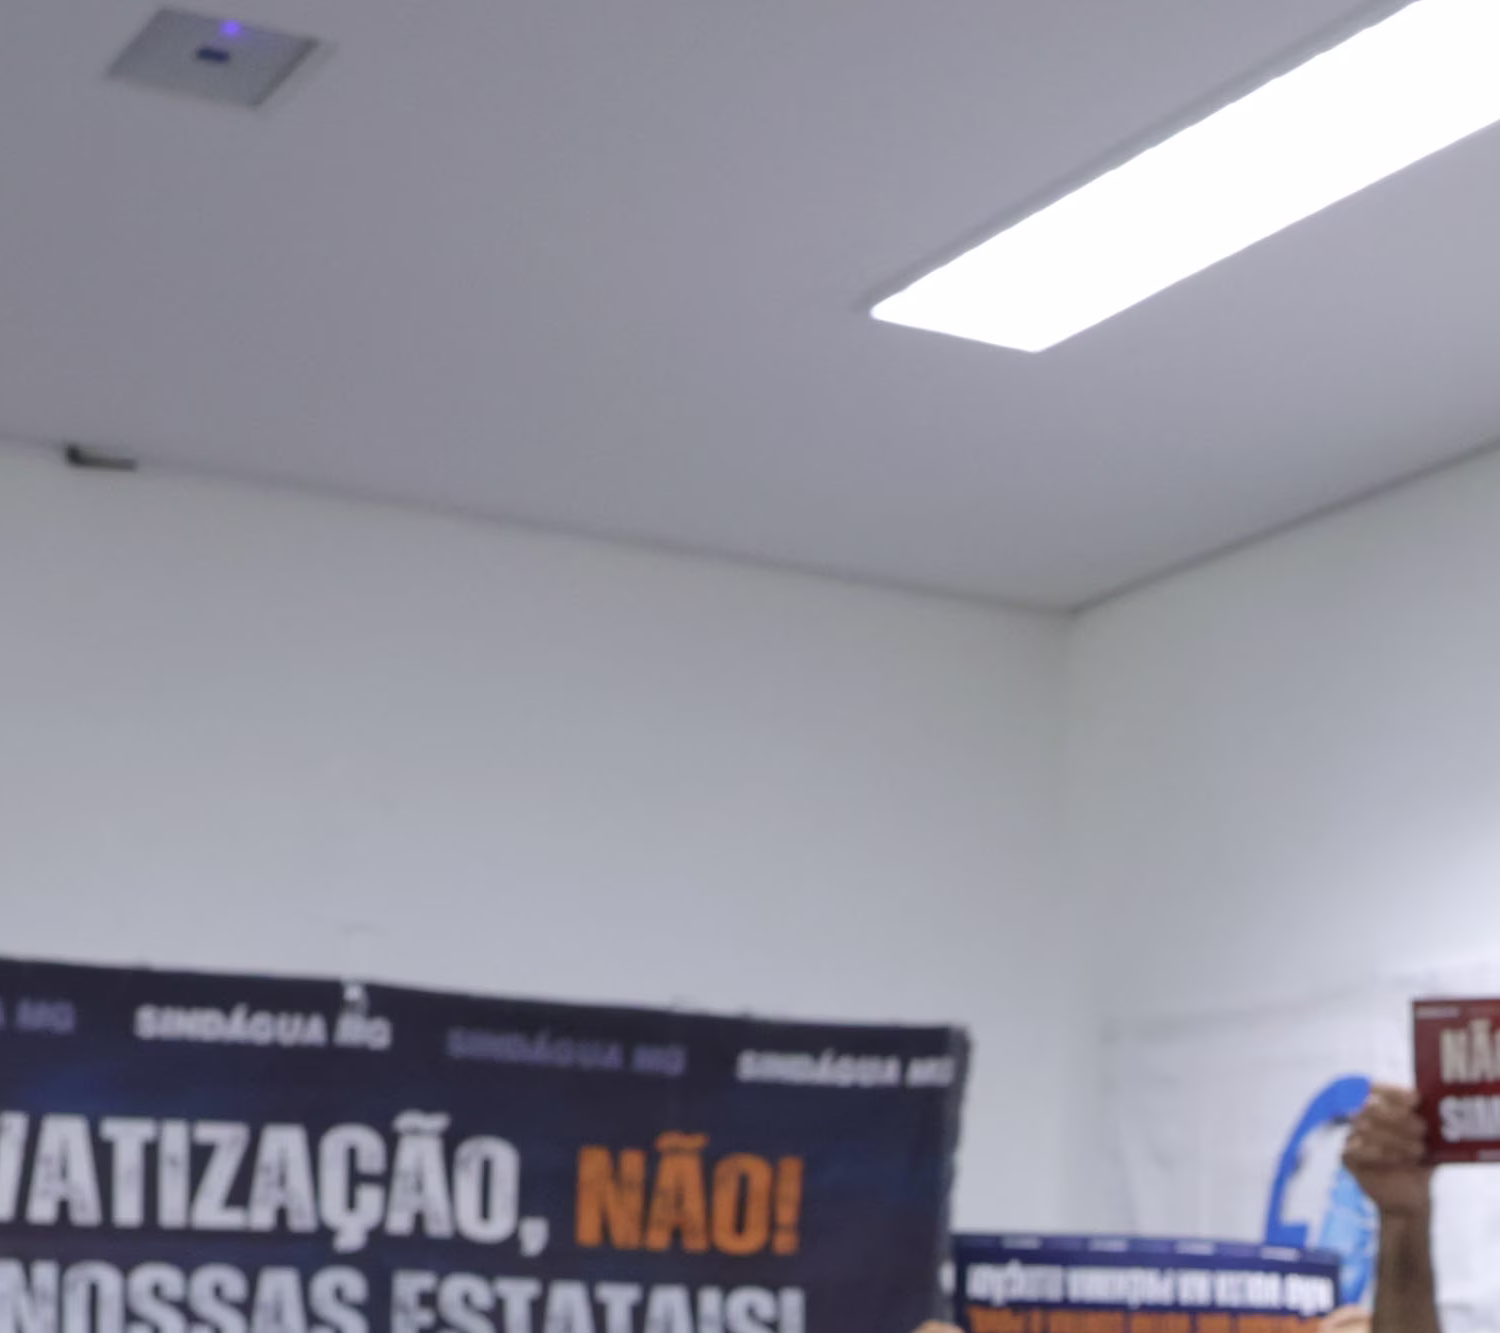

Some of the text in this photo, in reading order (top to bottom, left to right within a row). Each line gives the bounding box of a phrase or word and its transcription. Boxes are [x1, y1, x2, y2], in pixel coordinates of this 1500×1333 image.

[135, 1003, 392, 1052] SINDÁGUA MG
[575, 1133, 803, 1254] NÃO!
